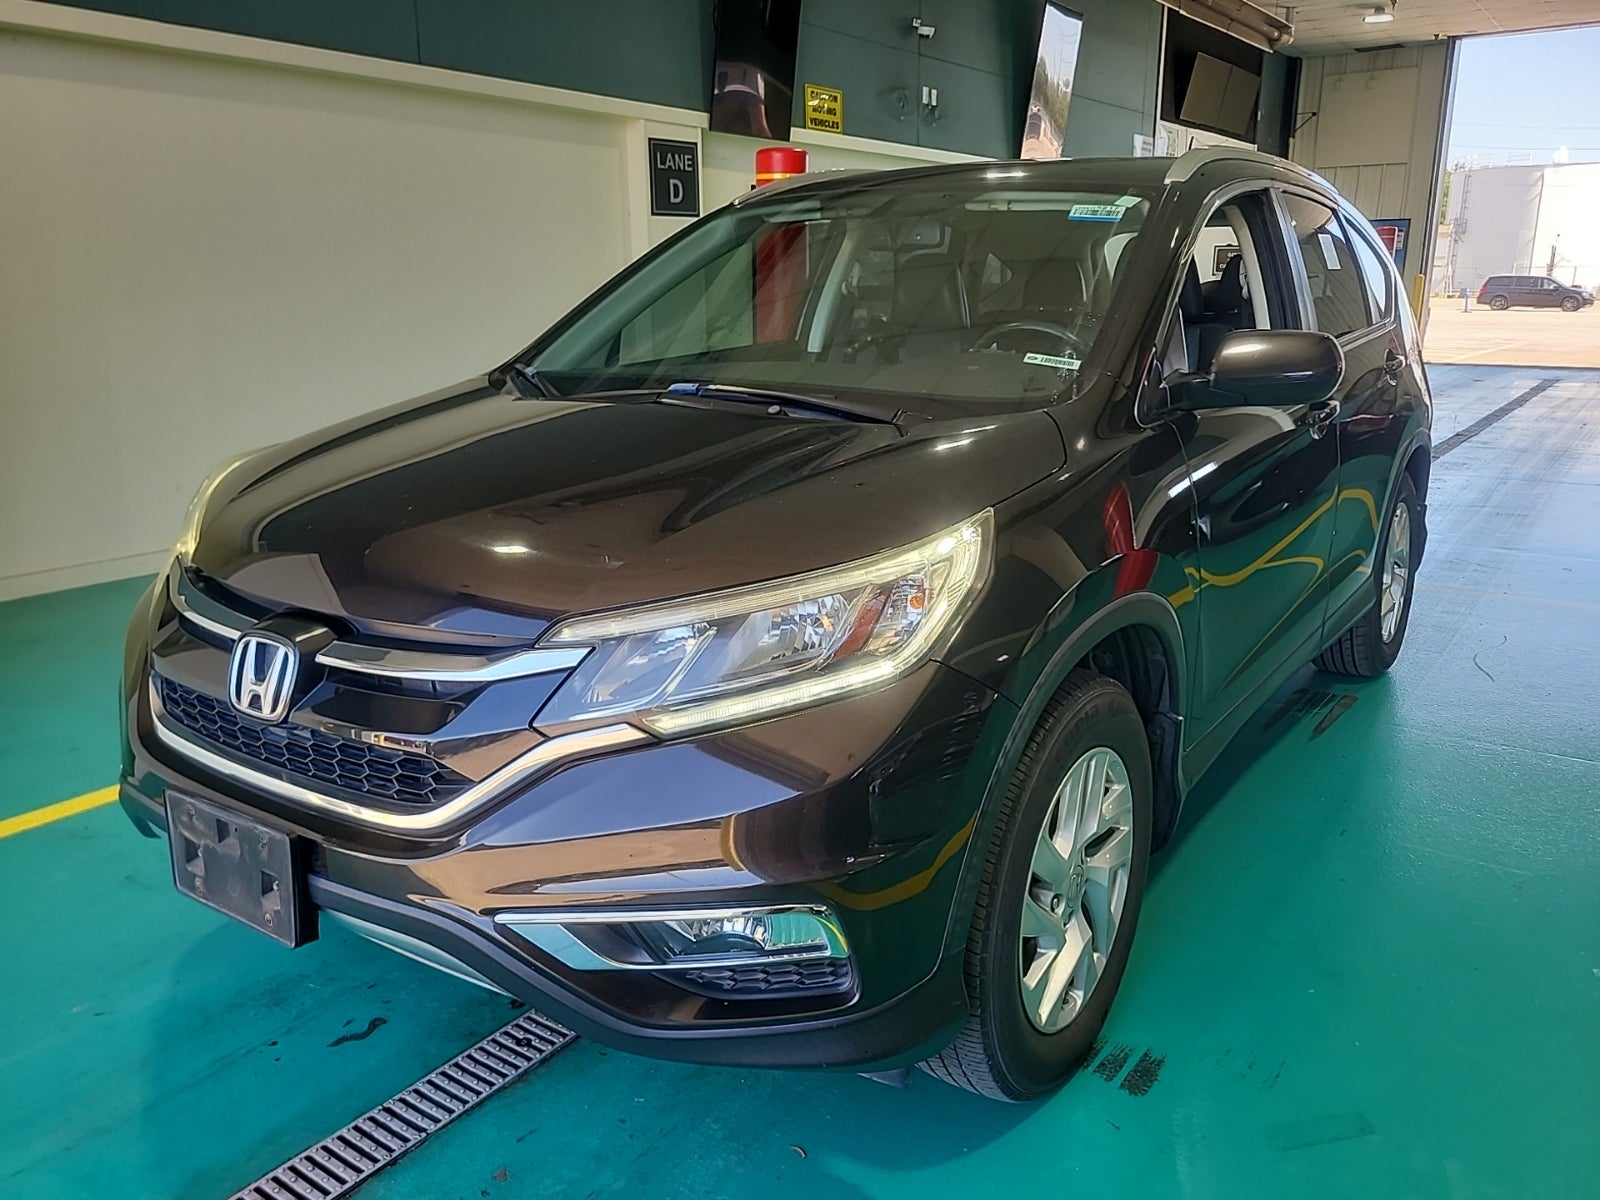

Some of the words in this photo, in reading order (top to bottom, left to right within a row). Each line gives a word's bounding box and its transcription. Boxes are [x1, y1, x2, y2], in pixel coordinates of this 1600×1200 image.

[810, 90, 838, 103] CAUON
[809, 117, 839, 130] VEHICLES
[657, 151, 693, 171] LANE
[669, 178, 683, 204] D
